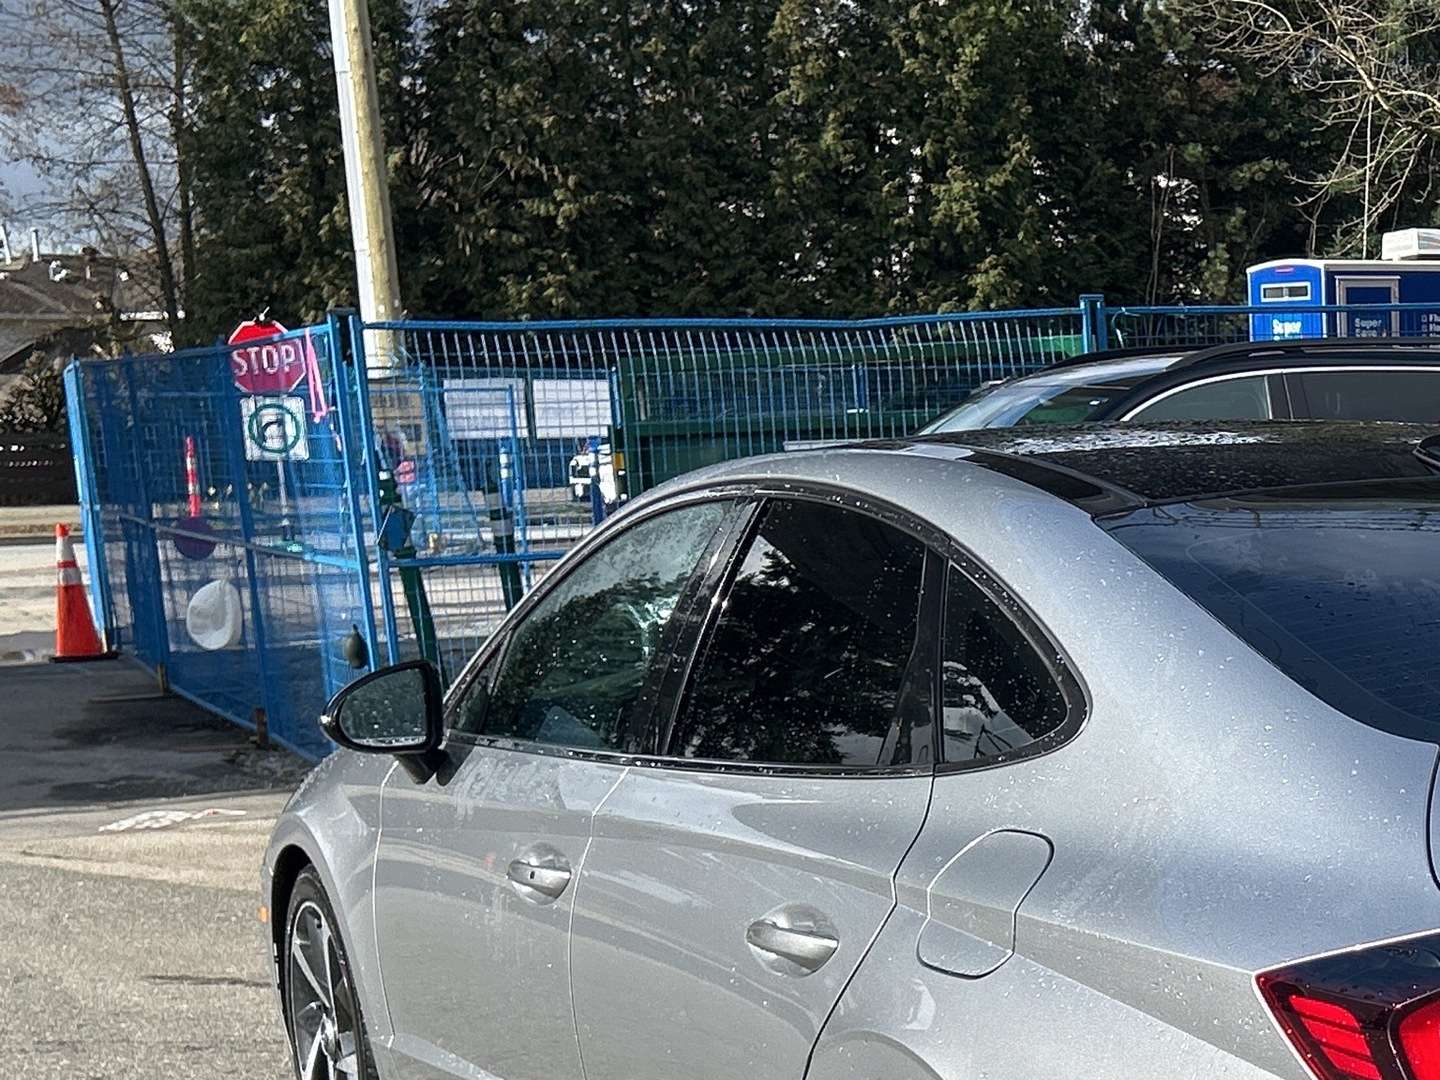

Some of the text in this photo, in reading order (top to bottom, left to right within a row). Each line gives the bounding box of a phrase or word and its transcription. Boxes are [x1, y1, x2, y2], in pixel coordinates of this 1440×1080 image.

[1272, 318, 1302, 337] Super
[1354, 318, 1382, 329] Super
[232, 344, 296, 376] STOP
